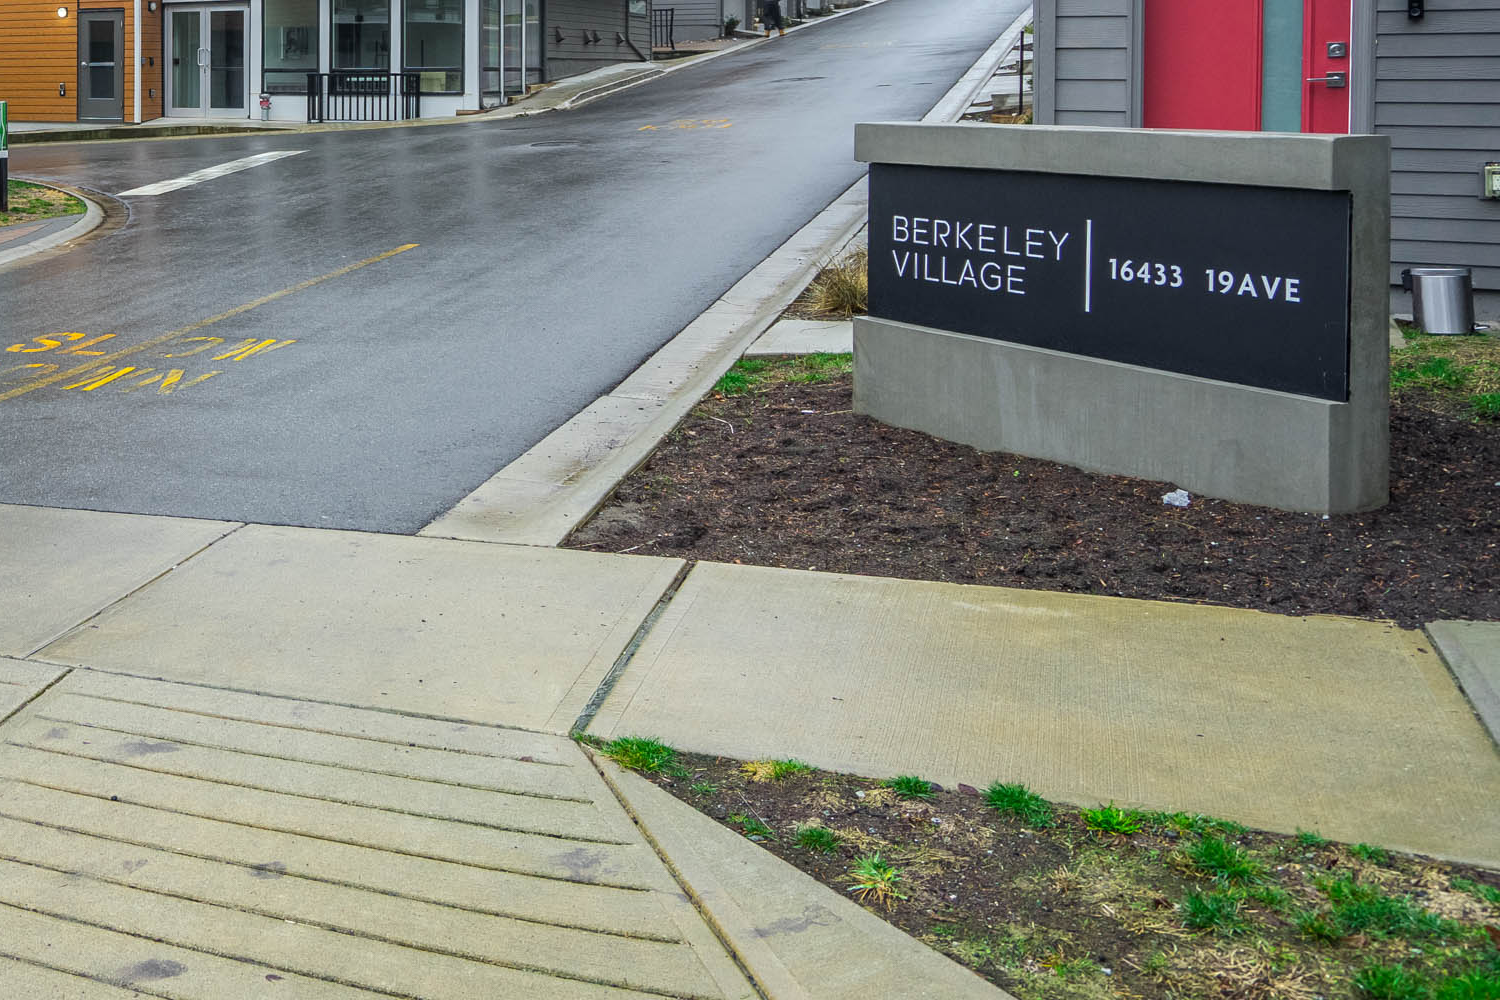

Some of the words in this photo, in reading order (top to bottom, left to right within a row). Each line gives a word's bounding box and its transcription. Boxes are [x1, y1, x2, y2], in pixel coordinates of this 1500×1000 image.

[893, 215, 1069, 260] BERKELEY
[892, 249, 1026, 295] VILLAGE
[1109, 258, 1184, 288] 16433
[6, 332, 297, 362] SLOW
